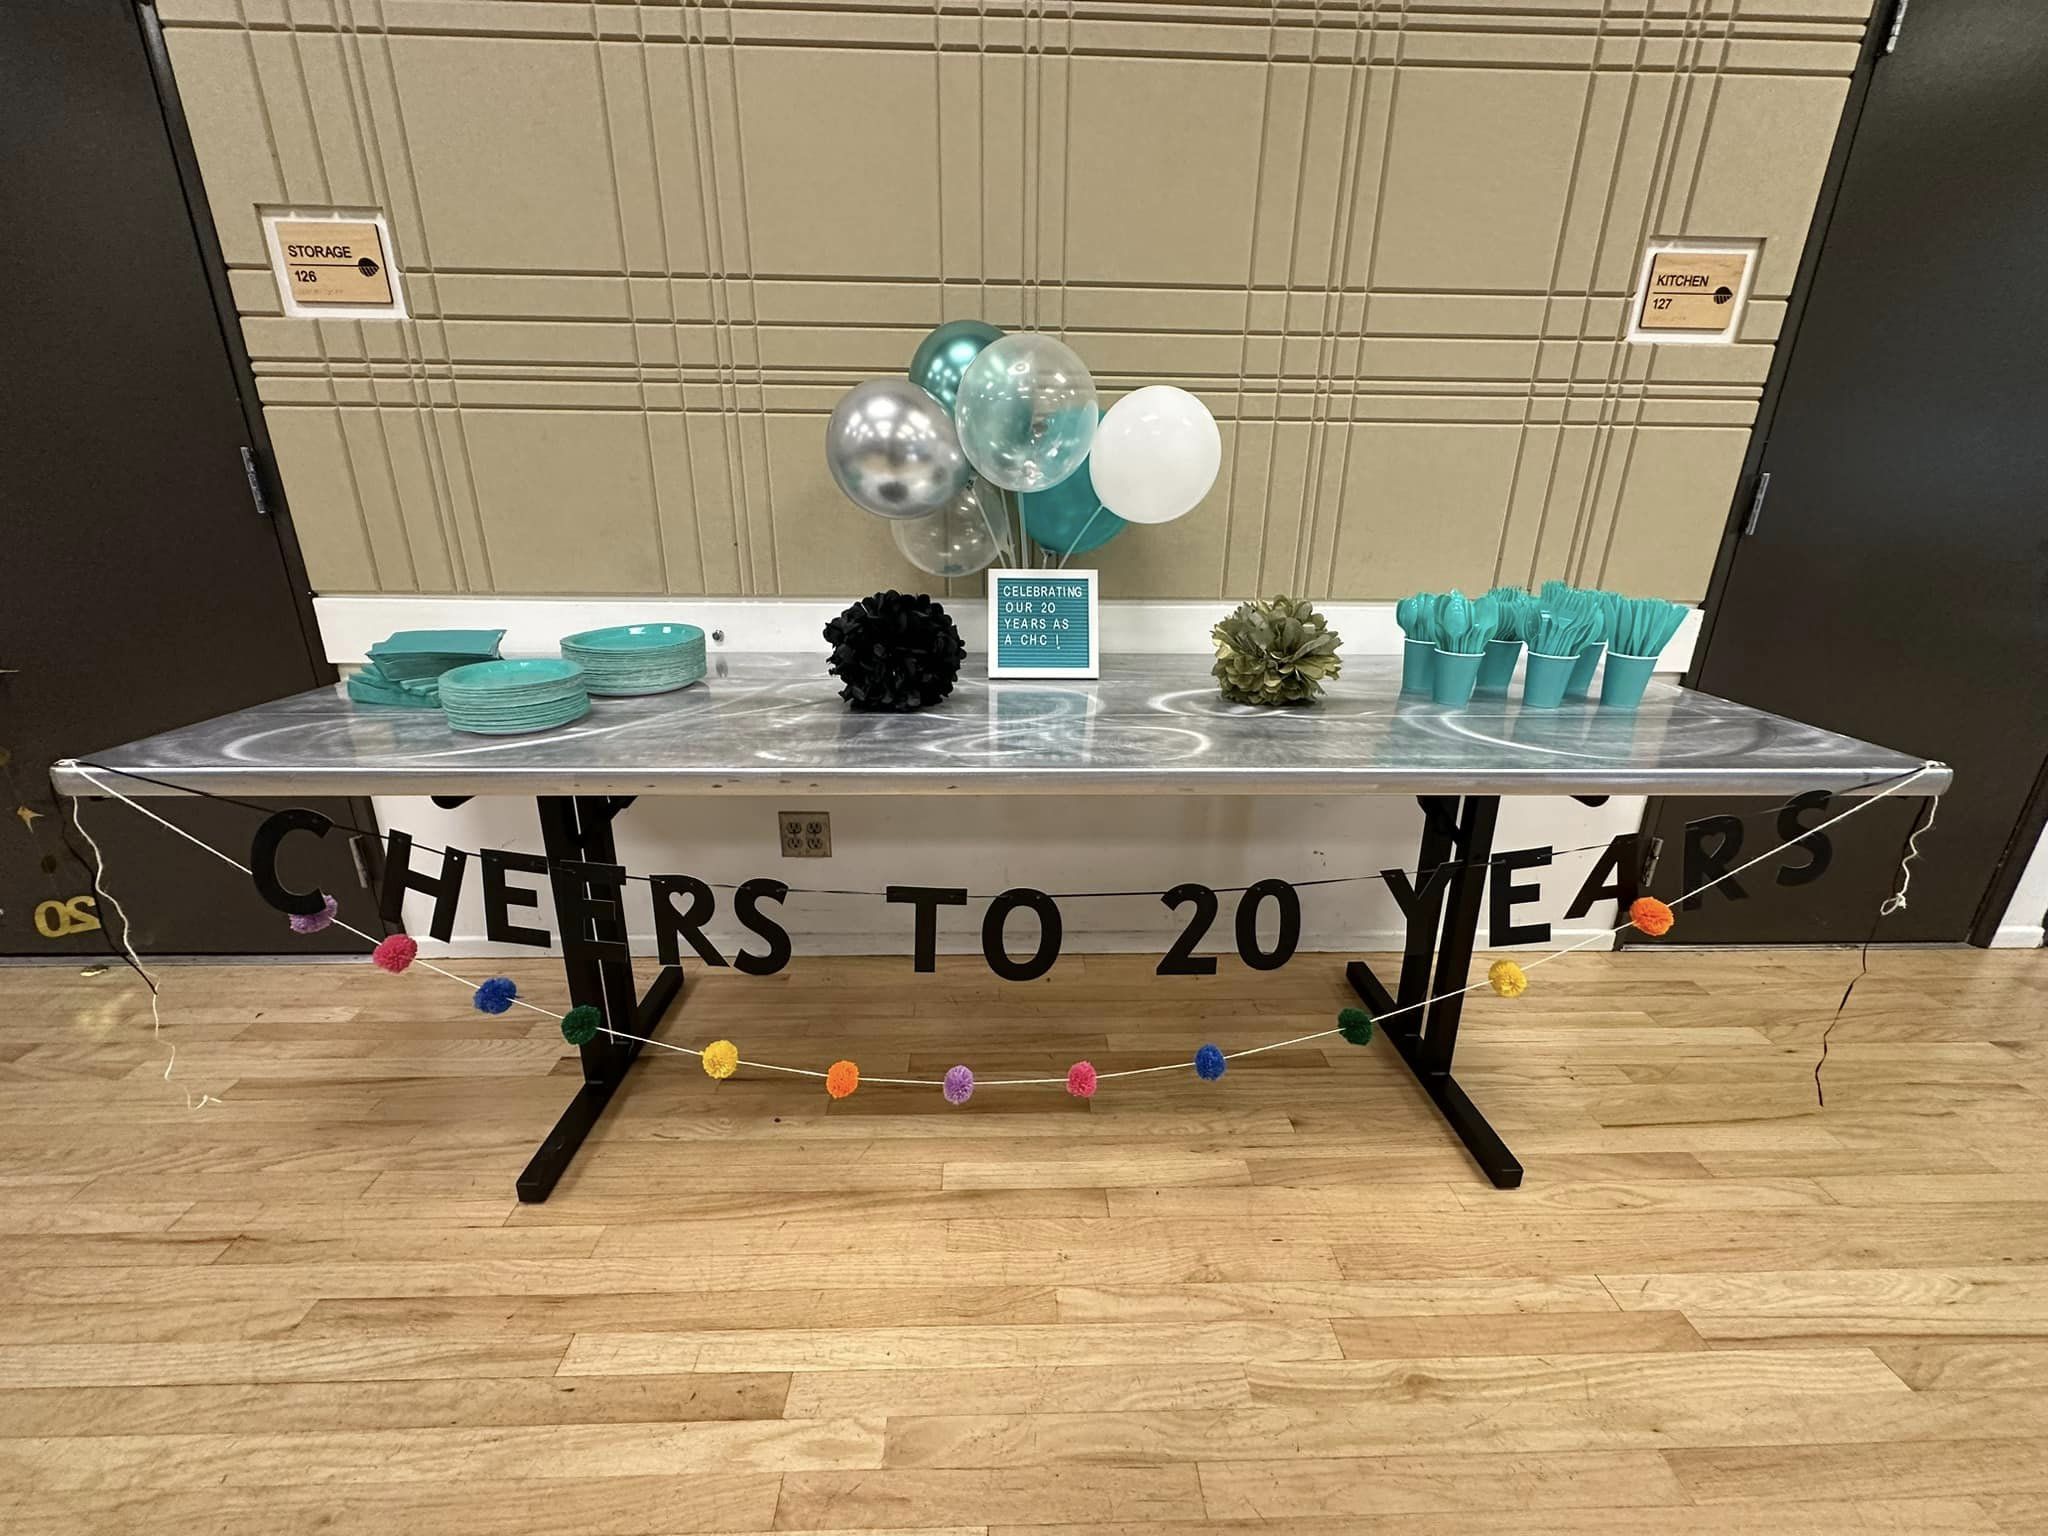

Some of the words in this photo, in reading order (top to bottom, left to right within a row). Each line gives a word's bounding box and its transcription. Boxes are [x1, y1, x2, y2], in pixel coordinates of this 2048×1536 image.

[288, 246, 352, 258] STORAGE
[295, 270, 317, 282] 126
[1657, 275, 1709, 287] KITCHEN
[1653, 298, 1672, 310] 127
[1003, 586, 1082, 597] CELEBRATING
[1005, 602, 1033, 613] OUR
[1041, 602, 1056, 613] 20
[1004, 618, 1046, 629] YEARS
[1053, 618, 1069, 629] AS
[1004, 634, 1012, 645] A
[1020, 634, 1047, 645] CHC
[250, 807, 792, 976] CHEERS
[886, 886, 1063, 982] TO
[1156, 878, 1301, 975] 20
[1380, 789, 1834, 956] YEARS
